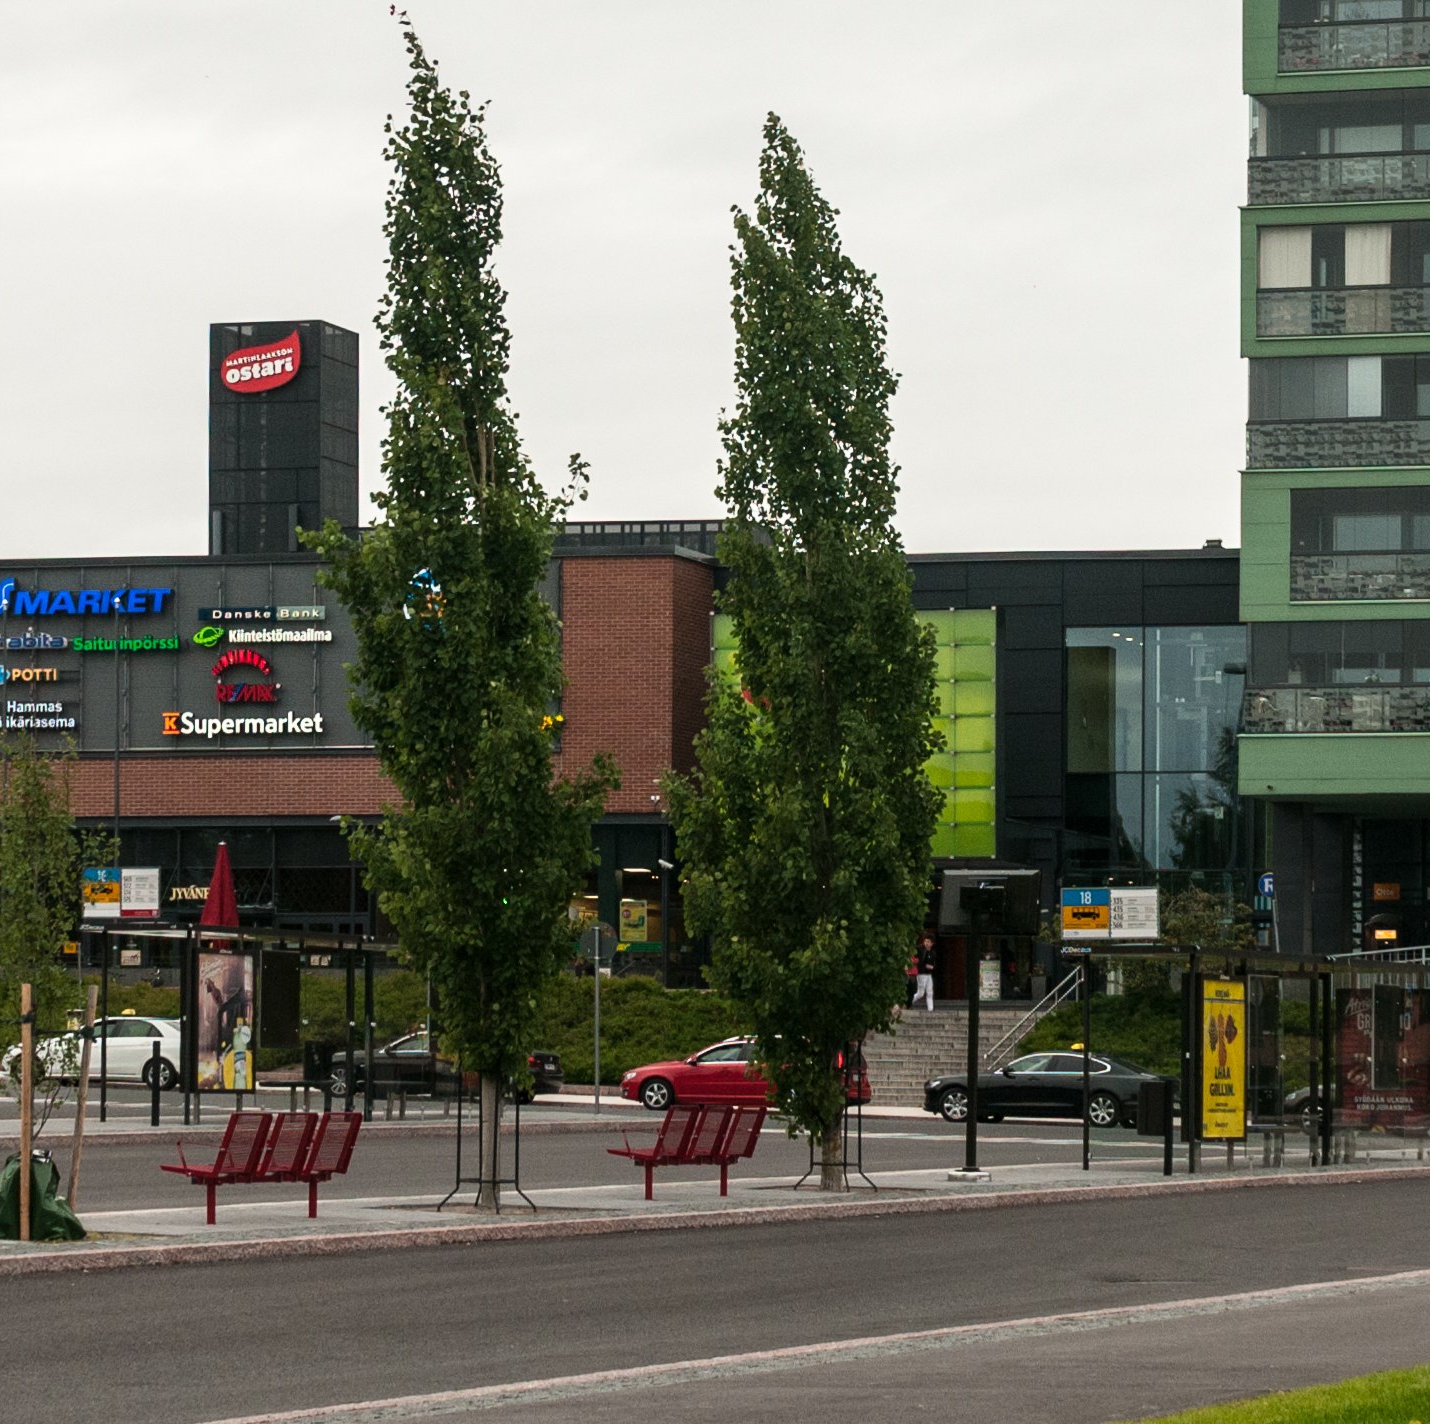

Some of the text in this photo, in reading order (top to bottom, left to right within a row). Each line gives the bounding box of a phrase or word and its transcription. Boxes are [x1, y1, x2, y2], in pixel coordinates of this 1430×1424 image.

[226, 347, 293, 367] MARTINLAAKSON
[225, 356, 293, 384] ostari
[212, 608, 321, 620] Danske Bank
[228, 628, 333, 644] Kiinteistömaailma
[11, 668, 58, 682] POTTI
[7, 700, 63, 713] Hammas
[1079, 891, 1092, 905] 18
